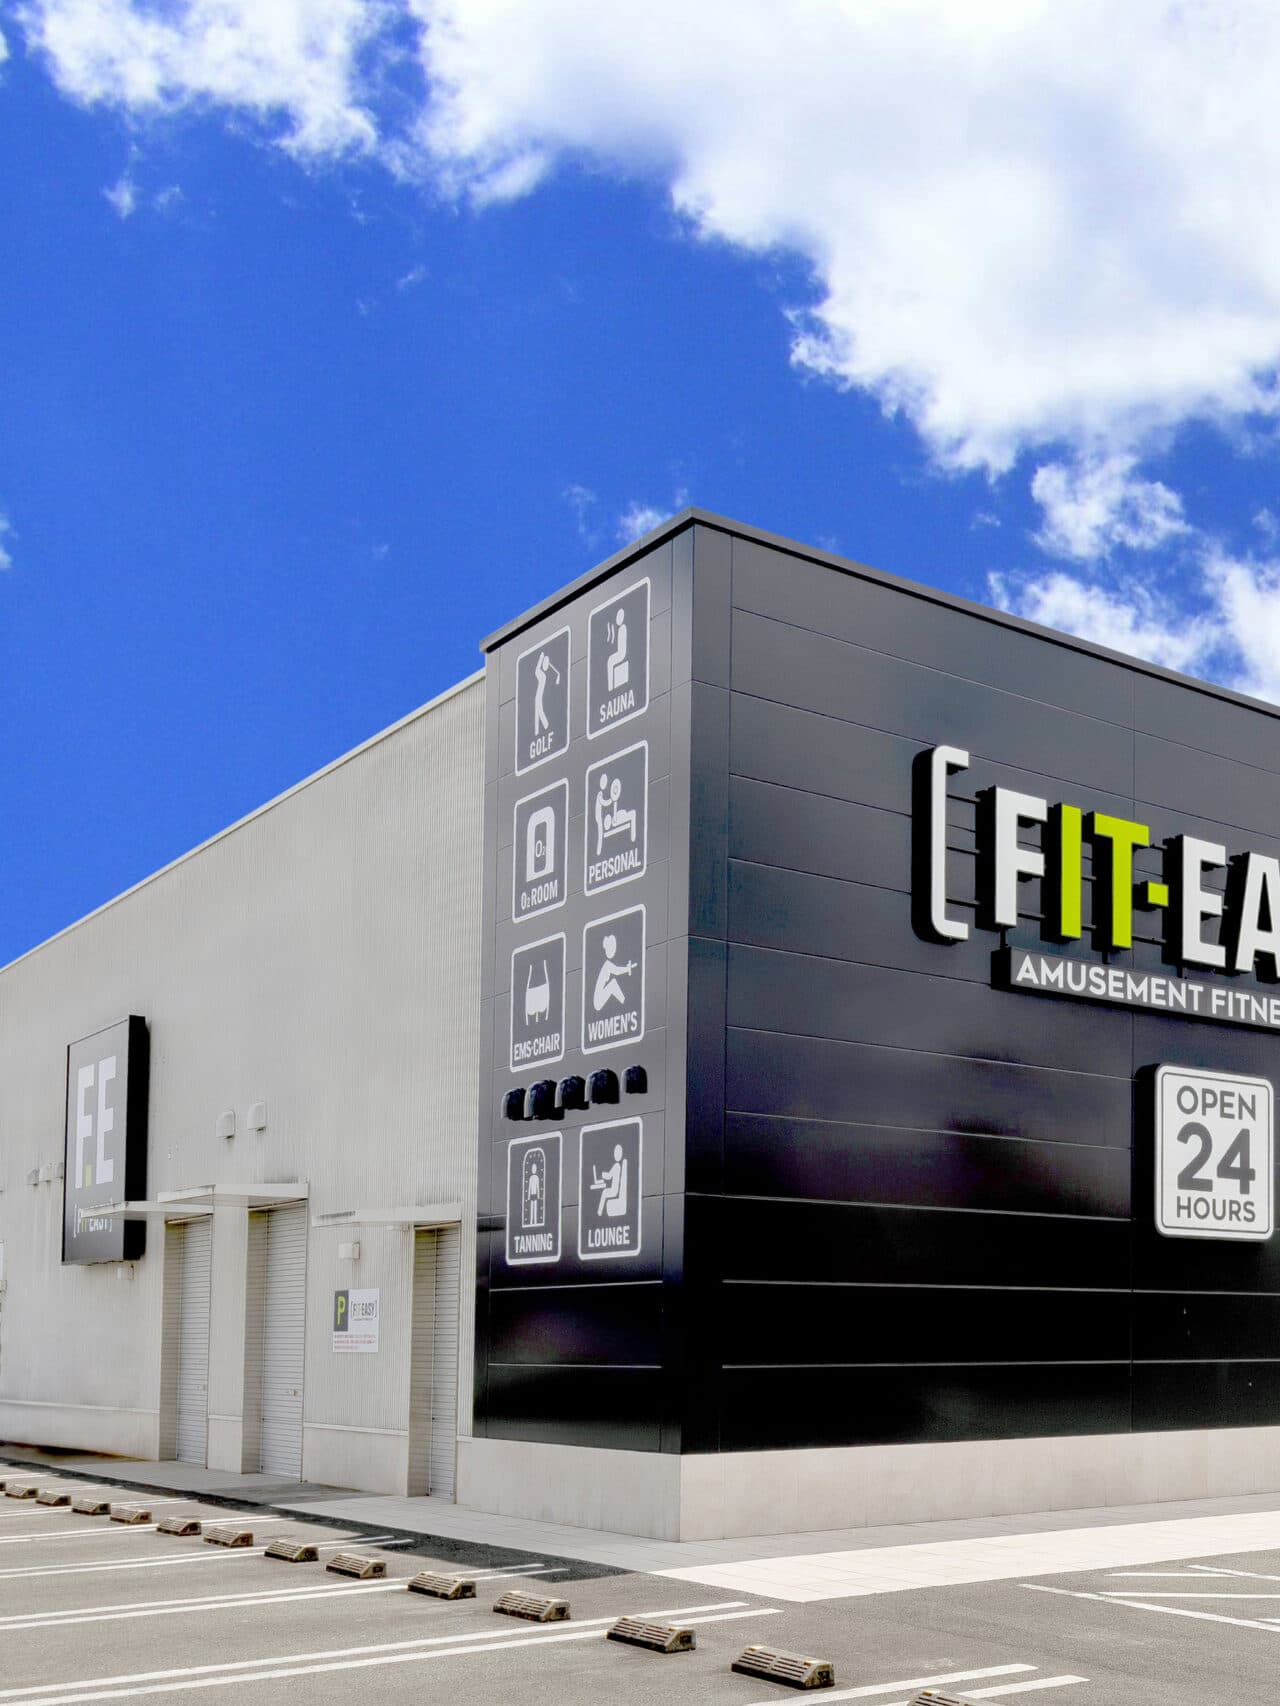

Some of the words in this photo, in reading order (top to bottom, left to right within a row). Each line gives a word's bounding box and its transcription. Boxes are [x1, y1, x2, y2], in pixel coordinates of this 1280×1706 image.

[599, 689, 636, 723] SAUNA
[529, 731, 554, 759] GOLF
[588, 848, 641, 884] PERSONAL
[1016, 955, 1204, 1011] AMUSEMENT
[588, 1012, 638, 1041] WOMEN'S
[1176, 1085, 1256, 1121] OPEN
[1177, 1122, 1256, 1195] 24
[1176, 1196, 1256, 1223] HOURS
[514, 1233, 552, 1253] TANNING
[588, 1226, 630, 1248] LOUNGE
[337, 1296, 346, 1325] P
